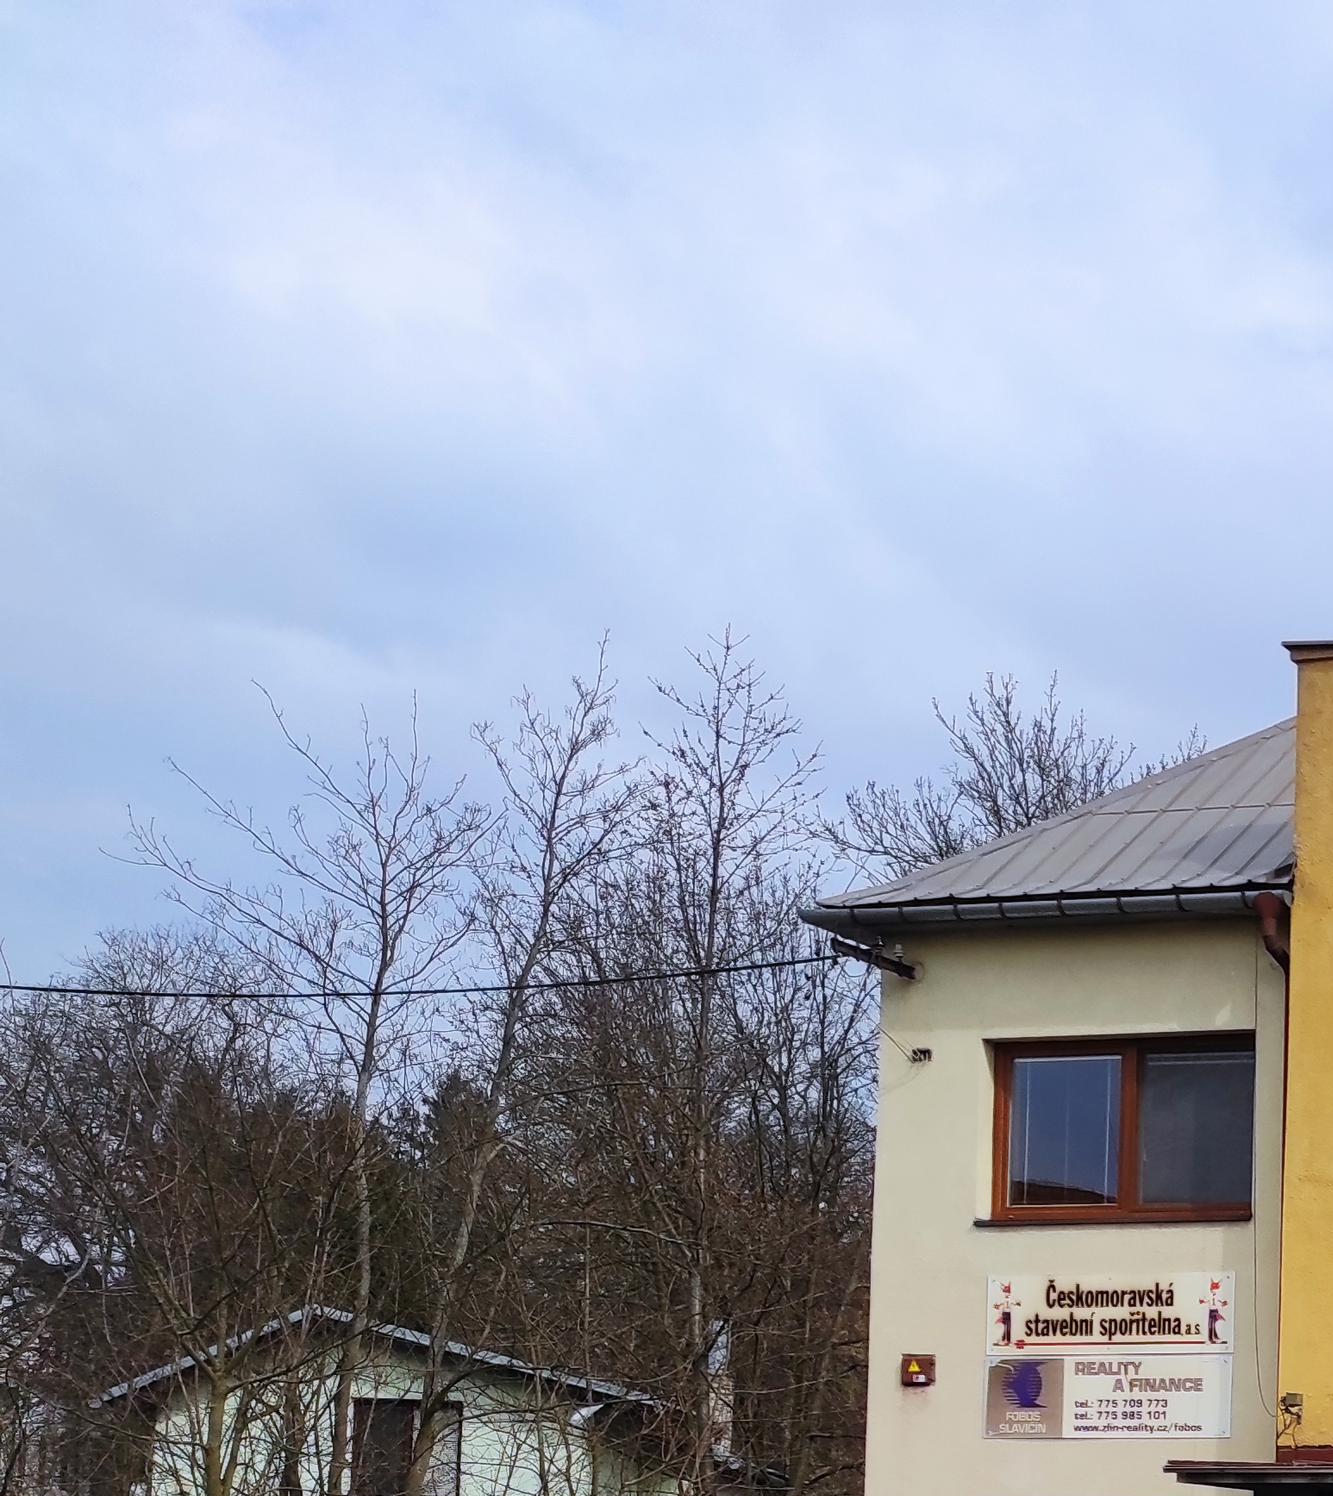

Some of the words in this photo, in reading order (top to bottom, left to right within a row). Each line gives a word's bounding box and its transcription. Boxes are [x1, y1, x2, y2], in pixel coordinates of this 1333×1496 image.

[1046, 1279, 1174, 1309] Českomoravská
[1025, 1311, 1095, 1338] stavební
[1075, 1361, 1142, 1376] REALITY
[1112, 1378, 1125, 1393] A
[1129, 1378, 1204, 1393] FINANCE
[1097, 1399, 1118, 1409] 775
[1122, 1399, 1143, 1409] 709
[1147, 1399, 1168, 1409] 773
[1006, 1411, 1041, 1421] FOBOS
[1097, 1411, 1118, 1420] 775
[1121, 1411, 1142, 1420] 985
[1146, 1411, 1167, 1420] 101
